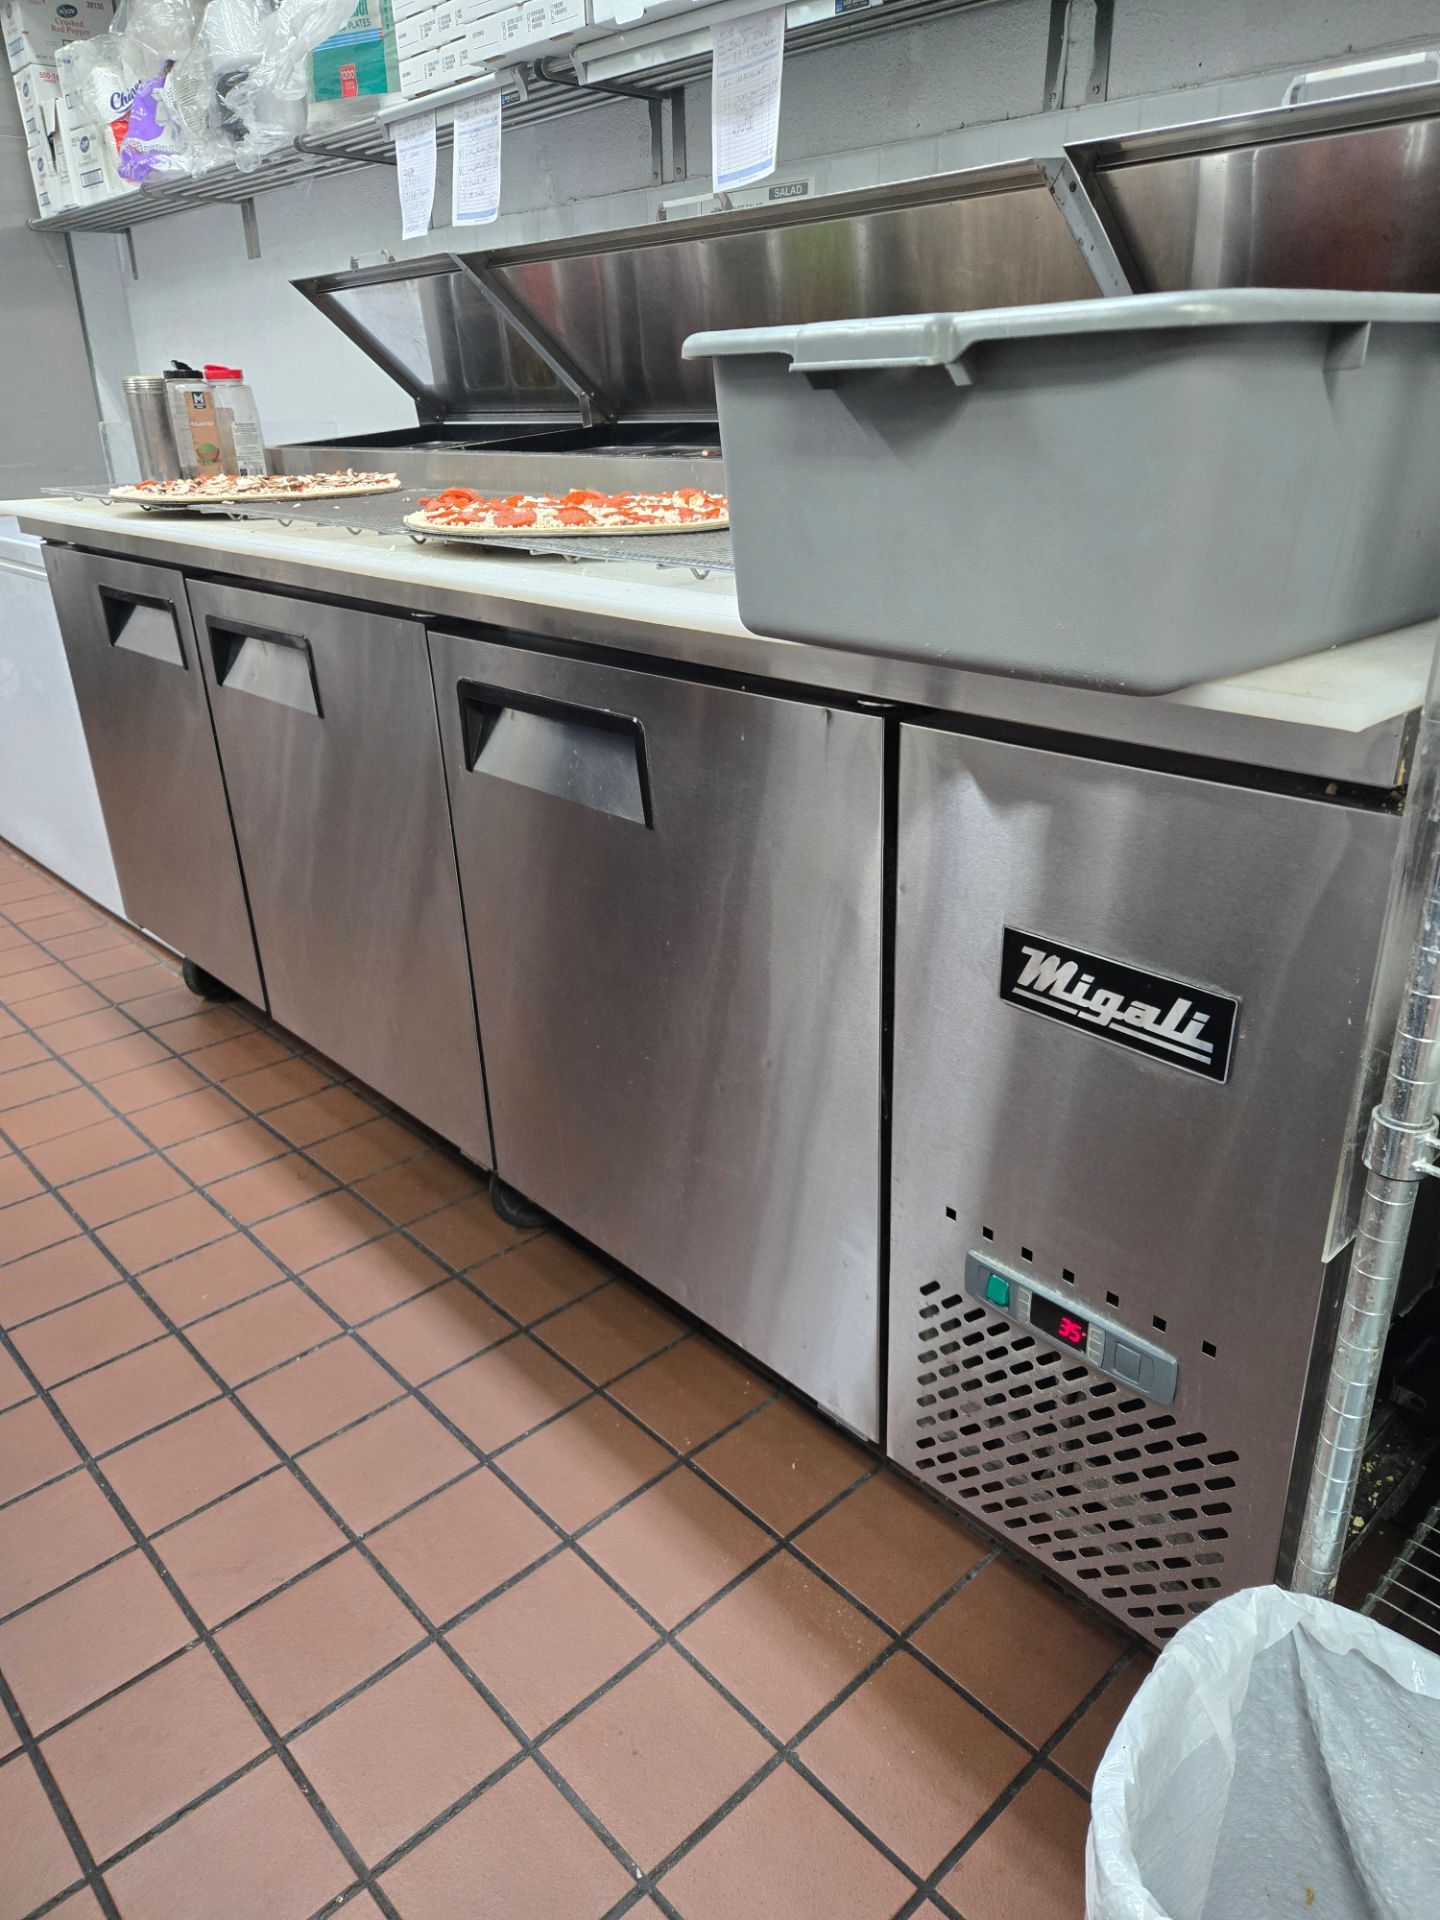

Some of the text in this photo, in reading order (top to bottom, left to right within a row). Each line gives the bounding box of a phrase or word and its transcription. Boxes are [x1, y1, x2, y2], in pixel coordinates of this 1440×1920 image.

[55, 18, 84, 28] Crushed
[347, 18, 371, 29] PLATES
[51, 25, 90, 36] Red Pepper
[774, 185, 803, 198] SALAD
[1016, 945, 1214, 1054] Migali
[1058, 1316, 1082, 1343] 35
